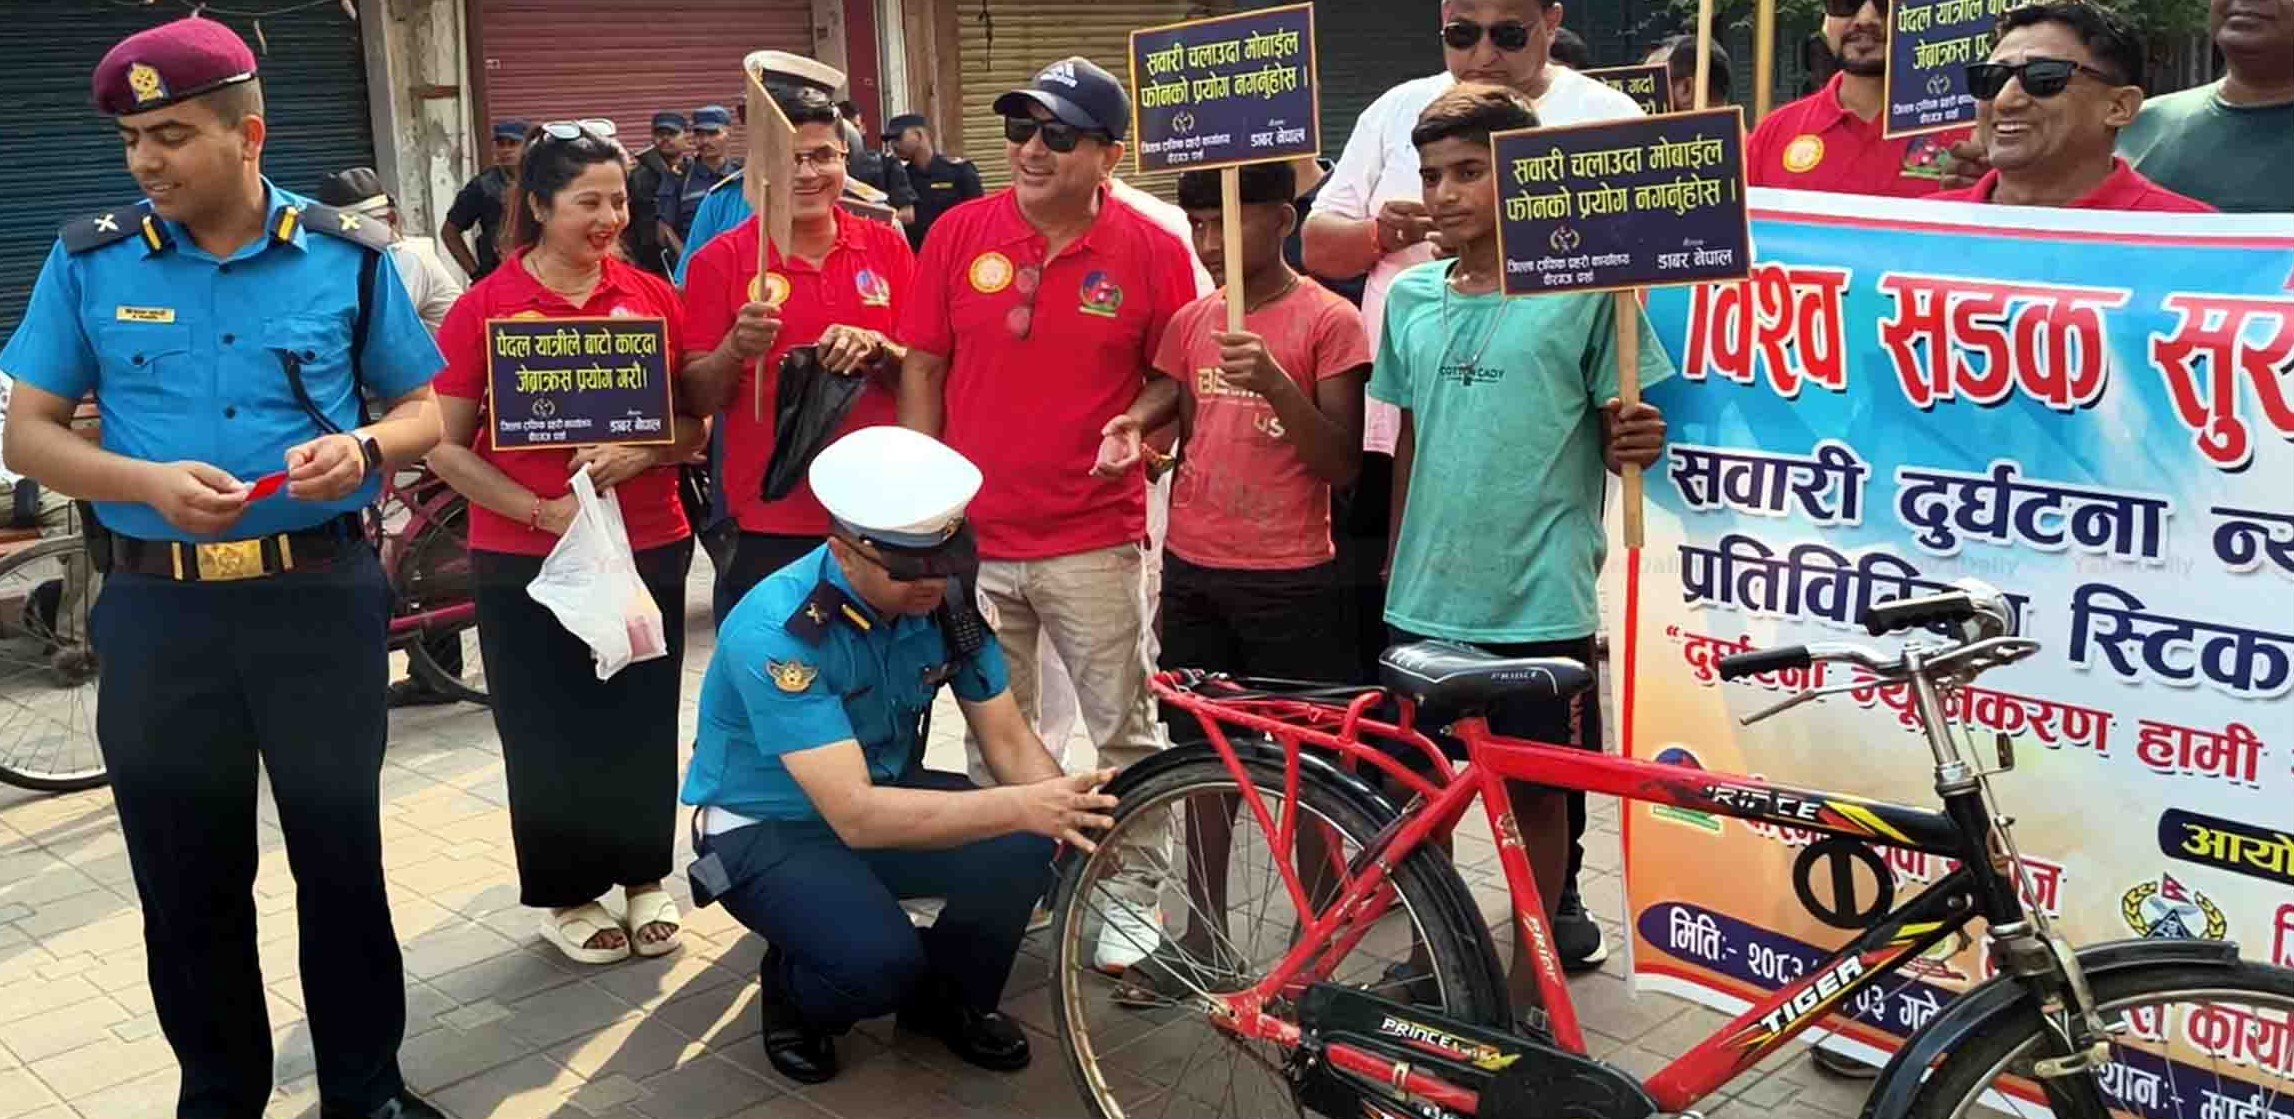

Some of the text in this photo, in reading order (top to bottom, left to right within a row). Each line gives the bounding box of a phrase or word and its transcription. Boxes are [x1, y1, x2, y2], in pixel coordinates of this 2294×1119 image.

[1147, 43, 1185, 76] सवारी
[1141, 76, 1189, 109] फोनको
[1193, 71, 1230, 104] प्रयोग
[1513, 147, 1565, 184] सवारी
[1506, 186, 1572, 222] फोनको
[1577, 182, 1628, 219] प्रयोग
[1692, 248, 1733, 268] नेपाल
[496, 328, 531, 358] पैदल
[535, 328, 581, 358] यात्रीले
[1686, 266, 1845, 392] विश्व
[1882, 275, 2123, 404] सडक
[576, 362, 613, 393] प्रयोग
[1672, 445, 1866, 521] सवारी
[1901, 467, 2167, 557] दुर्घटना
[2137, 722, 2265, 781] हामी
[1760, 955, 1864, 1034] TIGER
[1382, 1017, 1452, 1049] PRINCE
